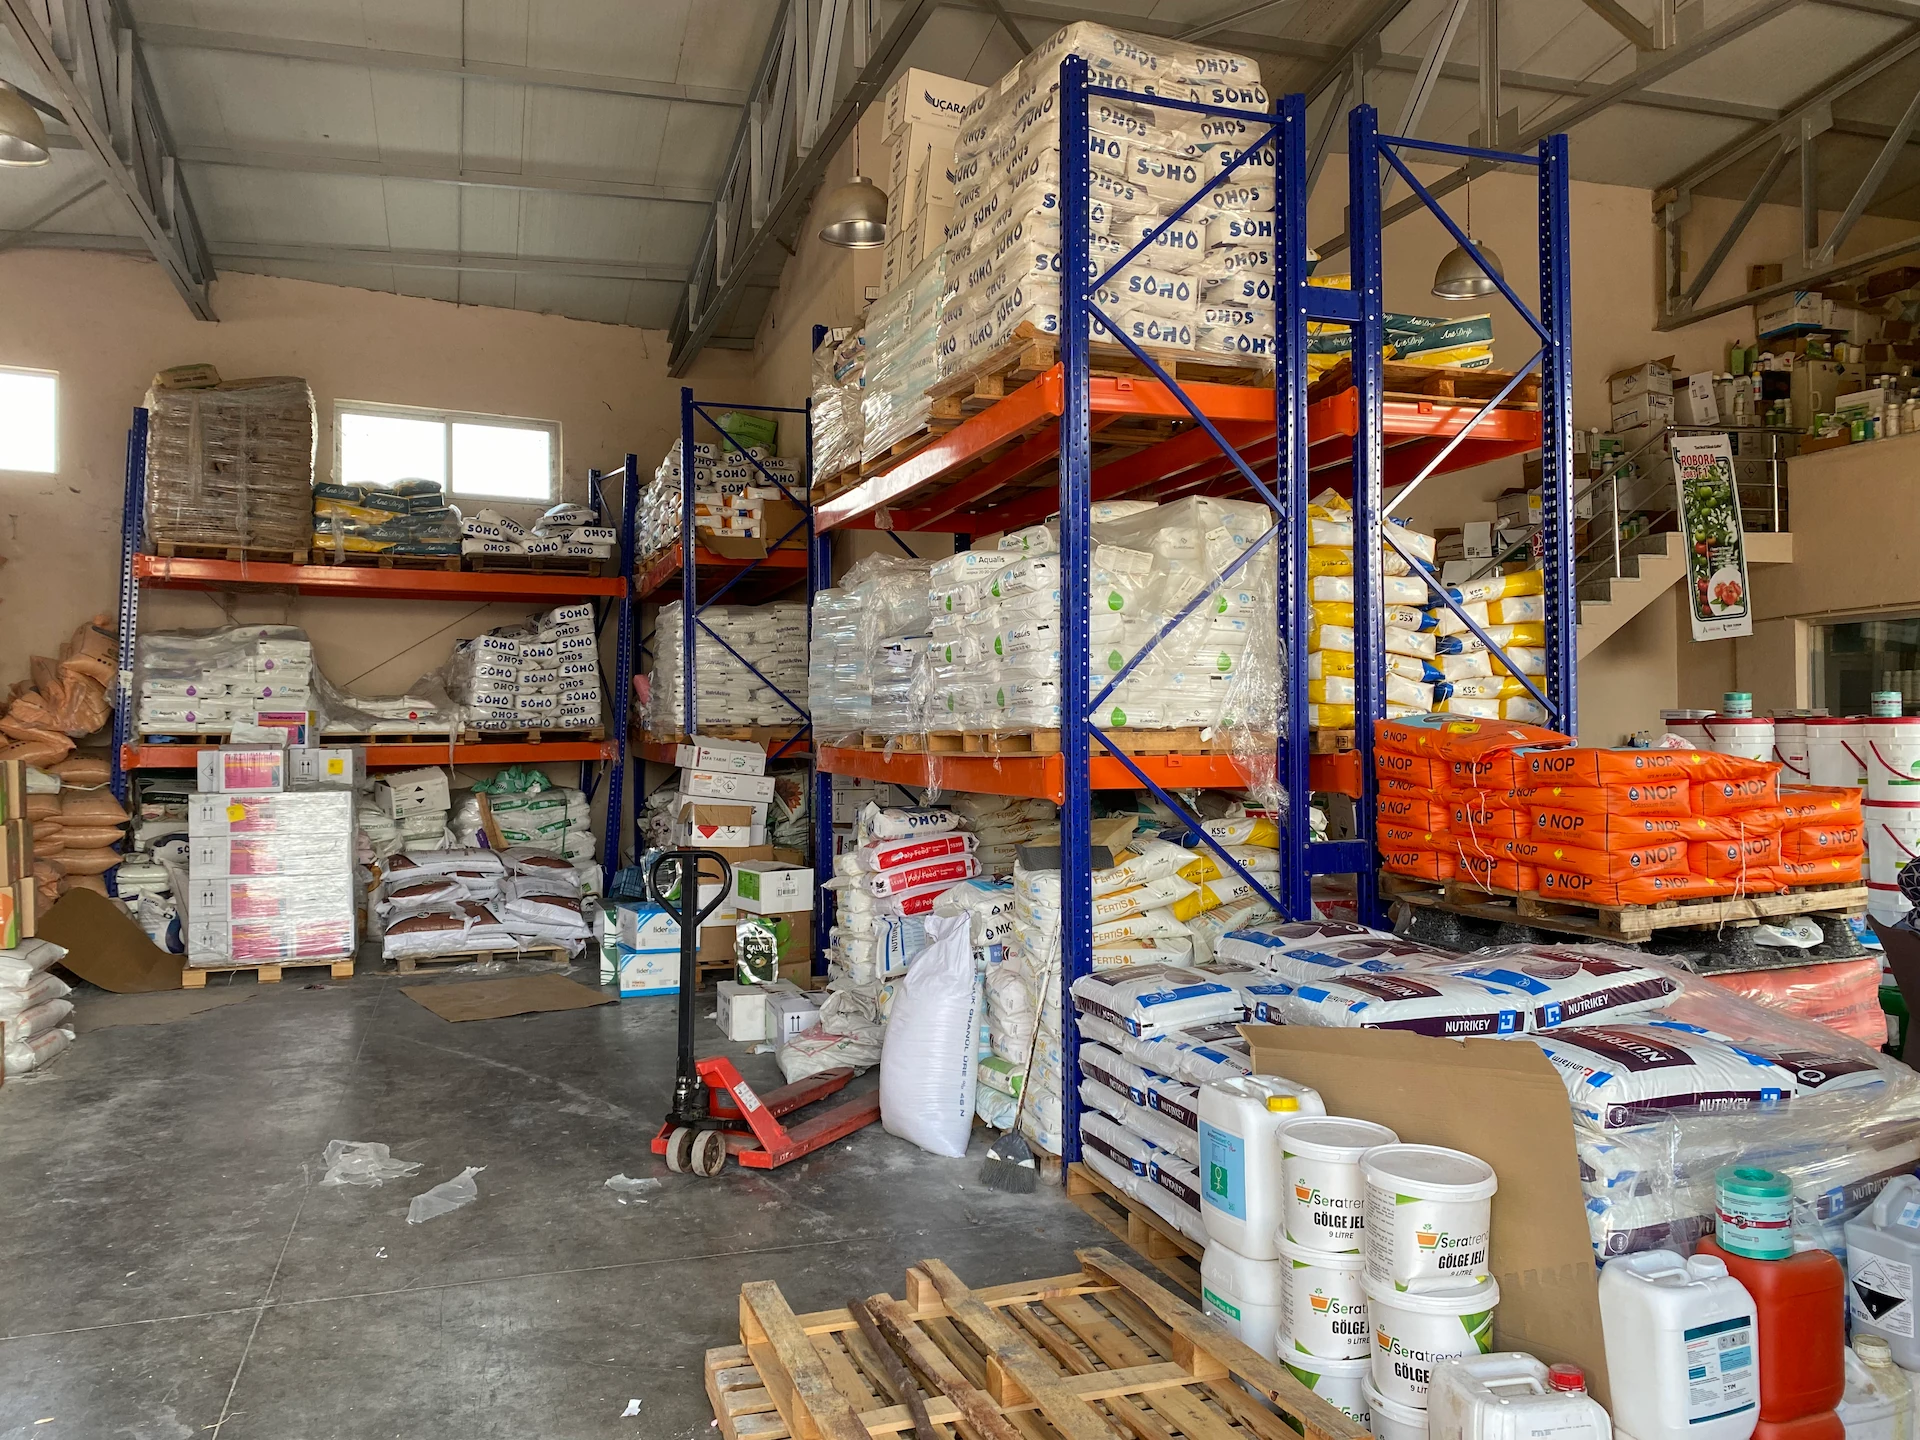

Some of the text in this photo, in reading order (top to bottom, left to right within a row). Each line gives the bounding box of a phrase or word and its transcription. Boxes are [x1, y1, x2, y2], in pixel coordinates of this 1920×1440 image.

[1196, 58, 1239, 75] SOHO
[1088, 65, 1128, 92] OHO
[1212, 87, 1266, 104] SOHO
[1201, 119, 1246, 140] SOHO
[1136, 157, 1197, 183] SOHO
[1213, 187, 1260, 209] SOHO
[1230, 218, 1273, 237] SOH
[1129, 275, 1189, 301] SOHO
[1132, 320, 1190, 345] SOHO
[1441, 327, 1473, 339] Ant Drip
[1681, 454, 1716, 466] ROBORA
[716, 468, 747, 478] SOHO
[468, 525, 499, 536] SOHO
[584, 530, 613, 538] SOHO
[527, 542, 558, 553] SOHO
[560, 608, 589, 619] SOHO
[556, 626, 580, 637] SOHO
[483, 639, 515, 651] SOHO
[562, 637, 592, 648] SOHO
[523, 648, 553, 657] SOHO
[564, 663, 594, 674] SOHO
[524, 673, 554, 682] SOHO
[566, 691, 596, 701] SOHO
[1463, 686, 1477, 694] KSC
[477, 695, 508, 705] SOHO
[521, 699, 551, 707] SOHO
[1390, 731, 1407, 742] NOP
[1387, 756, 1412, 770] NOP
[1544, 758, 1575, 772] NOP
[1647, 756, 1673, 767] NOP
[1643, 786, 1677, 800] NOP
[1736, 780, 1767, 795] NOP
[1388, 801, 1411, 814] NOP
[909, 813, 947, 828] SOHO
[1550, 814, 1584, 831] NOP
[1655, 821, 1680, 831] NOP
[1394, 830, 1412, 840] NOP
[1831, 829, 1859, 844] NOP
[1516, 843, 1538, 855] NOP
[1740, 838, 1771, 855] NOP
[1392, 853, 1419, 866] NOP
[1645, 846, 1677, 864] NOP
[1558, 874, 1593, 890] NOP
[1664, 877, 1688, 888] NOP
[1233, 886, 1248, 895] KSC
[1568, 995, 1609, 1015] NUTRIKEY
[1445, 1019, 1490, 1033] NUTRIKEY
[1551, 1056, 1584, 1071] unifarm
[1160, 1099, 1185, 1121] NUTRIKEY
[1700, 1098, 1750, 1112] NUTRIKEY
[1314, 1211, 1364, 1229] GÖLGE JEL
[1438, 1253, 1469, 1269] GÖLGE
[1332, 1302, 1368, 1315] Serat
[1332, 1320, 1365, 1334] GÖLGE
[1394, 1362, 1429, 1384] GÖLGE
[1417, 1386, 1428, 1394] LİT
